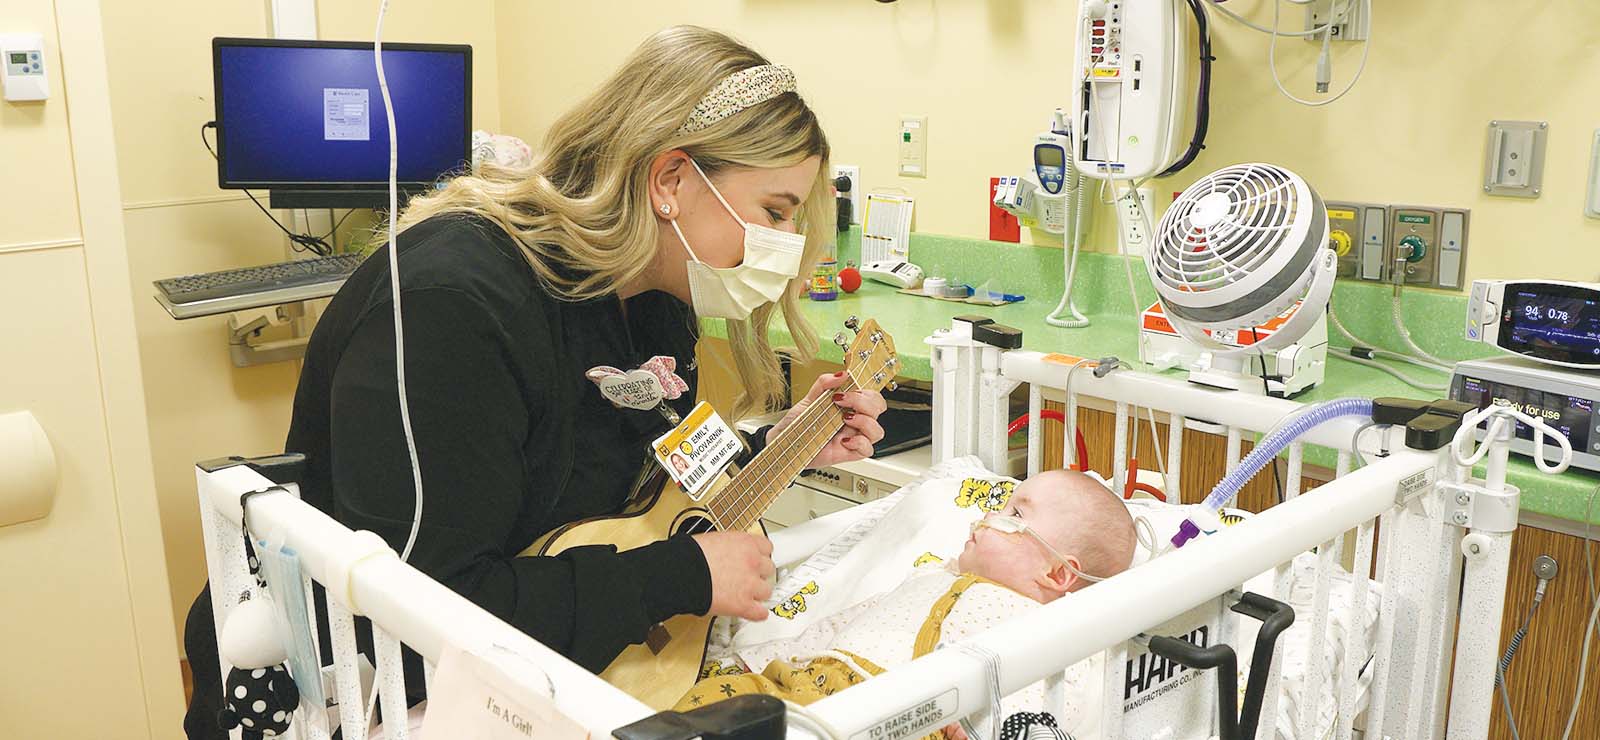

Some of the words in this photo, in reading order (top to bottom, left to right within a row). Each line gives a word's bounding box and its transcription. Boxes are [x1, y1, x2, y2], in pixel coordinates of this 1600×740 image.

[1525, 305, 1539, 317] 94
[1548, 308, 1568, 321] 0.78
[605, 377, 654, 394] CELEBRATING
[1525, 403, 1540, 416] for
[1541, 410, 1560, 421] use
[689, 426, 725, 461] PIVOVARNIK
[691, 424, 710, 445] EMILY
[710, 454, 721, 466] MM
[718, 439, 736, 458] MT-BC
[1123, 680, 1179, 714] MANUFACTURING
[487, 697, 501, 715] I'm
[502, 708, 510, 722] A
[511, 714, 532, 736] Girl!
[869, 726, 882, 738] TO
[885, 711, 913, 731] RAISE
[916, 700, 937, 717] SIDE
[888, 725, 909, 740] TWO
[912, 709, 943, 730] HANDS
